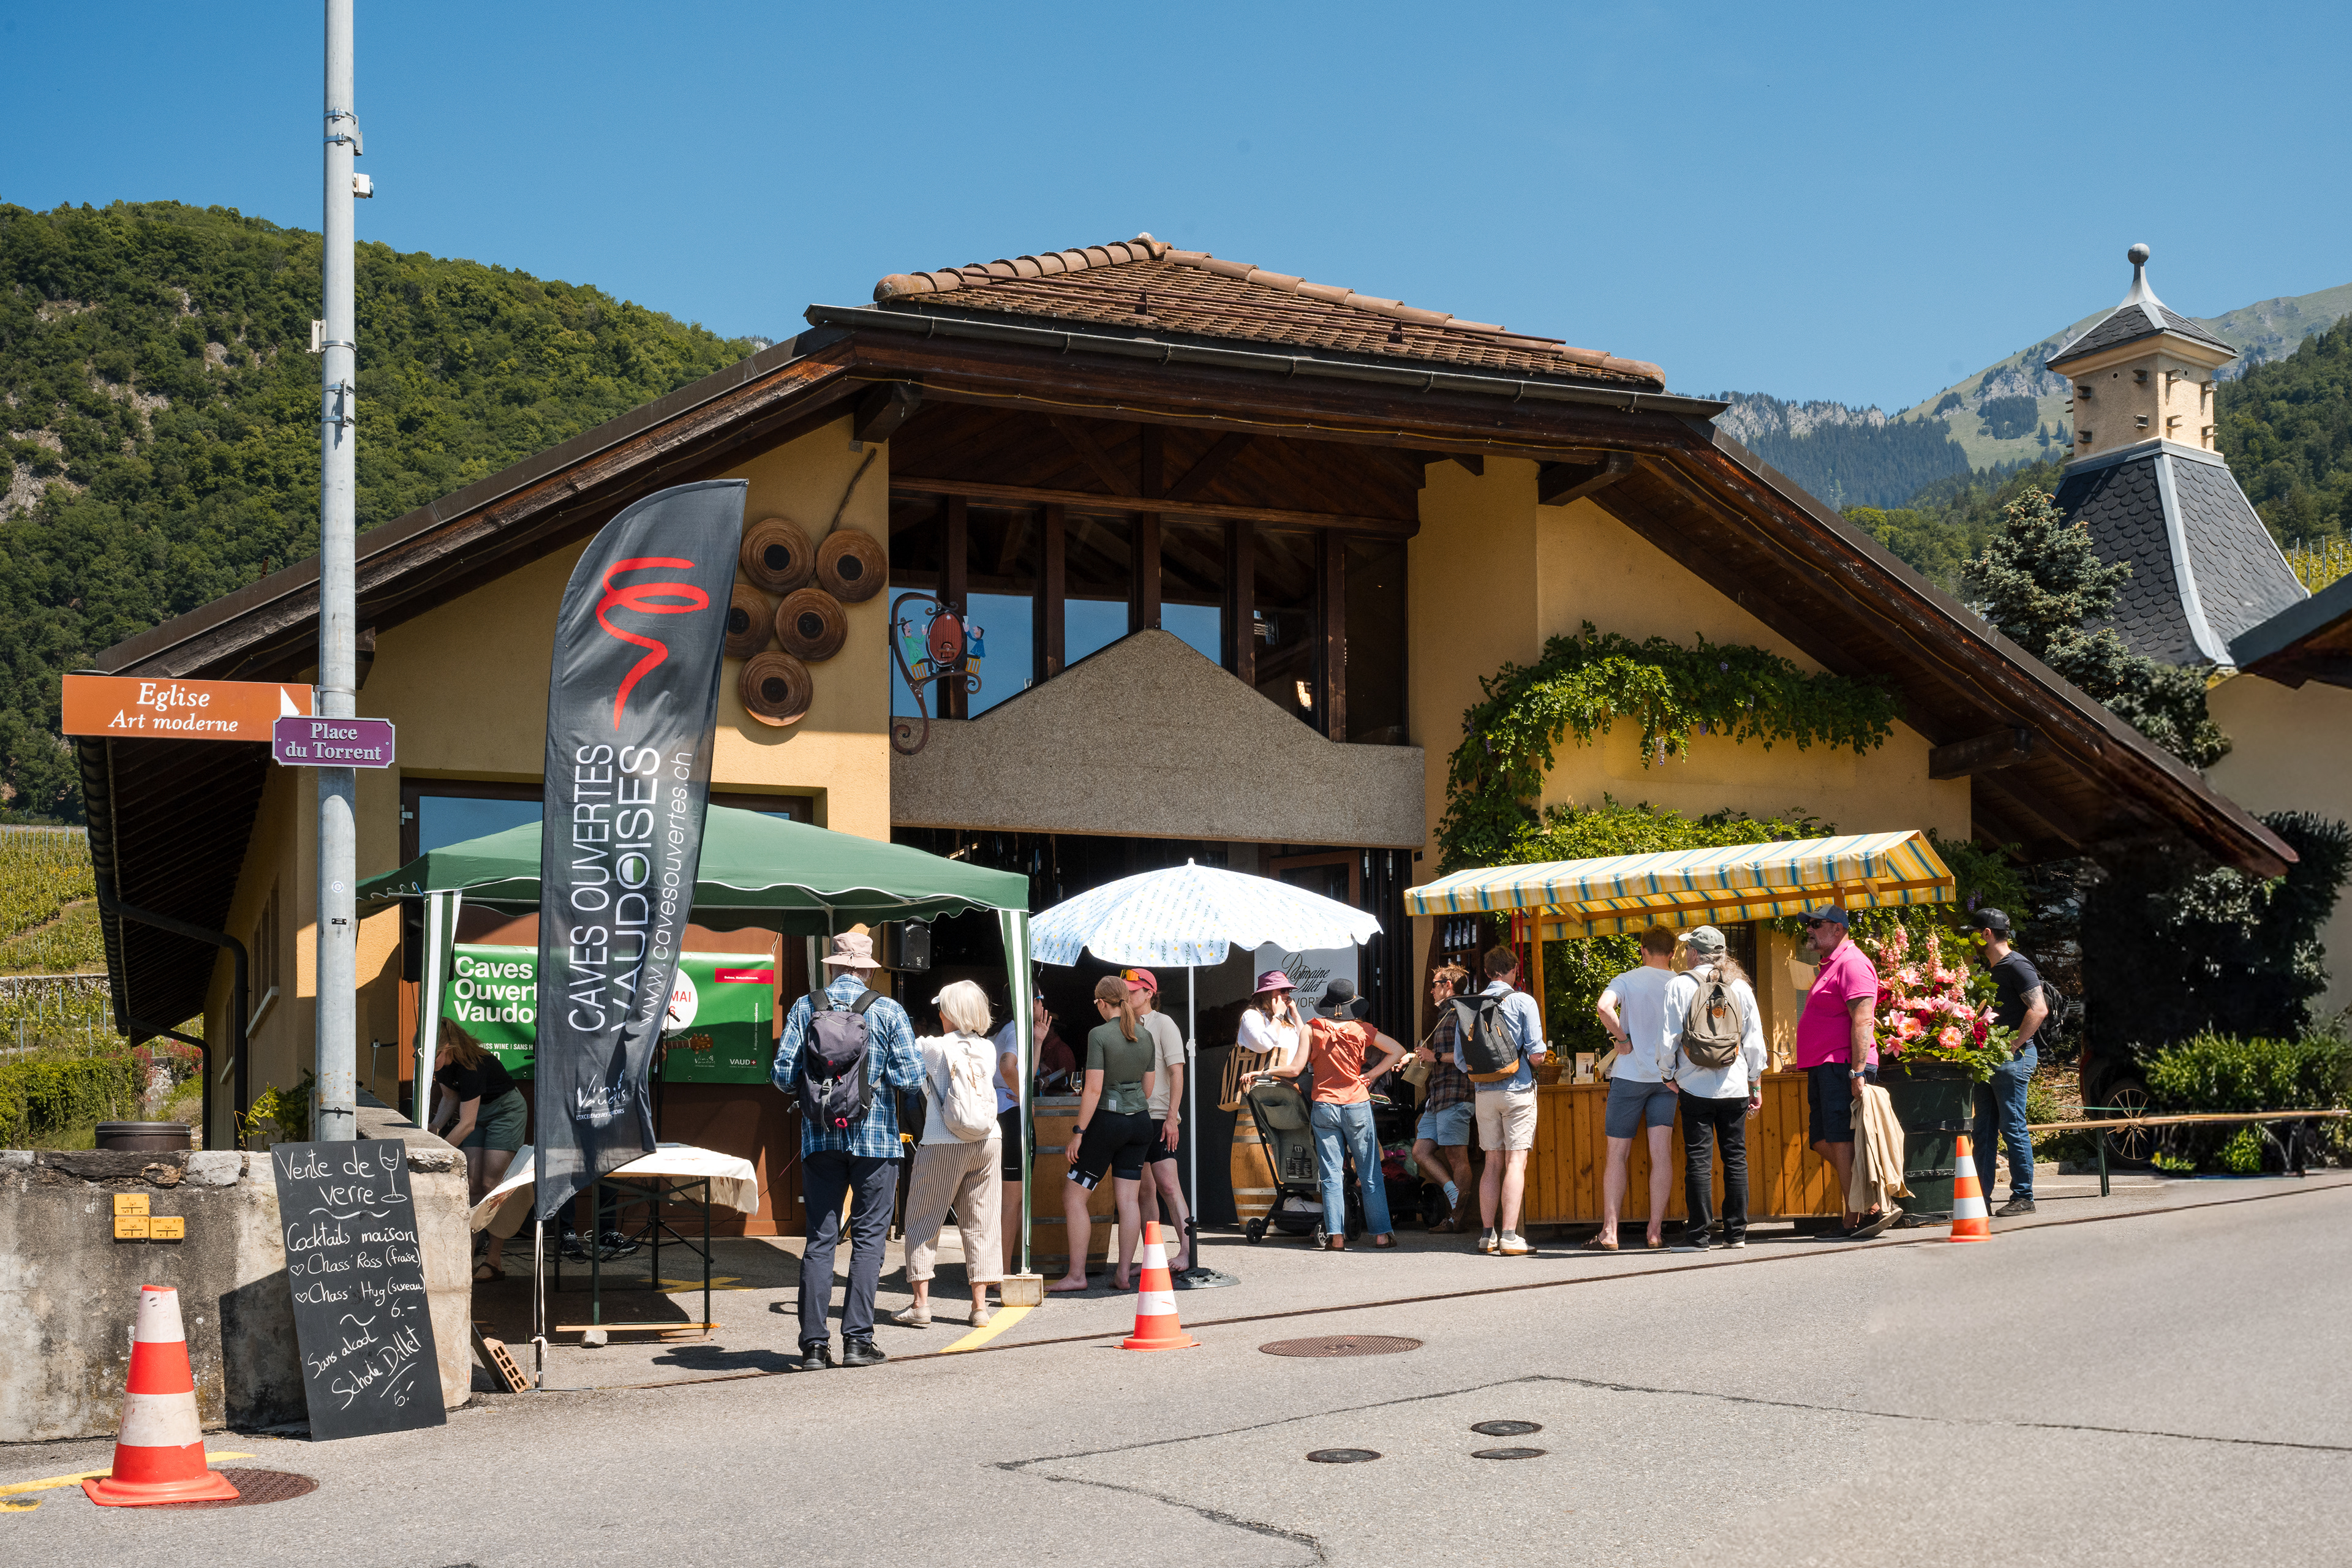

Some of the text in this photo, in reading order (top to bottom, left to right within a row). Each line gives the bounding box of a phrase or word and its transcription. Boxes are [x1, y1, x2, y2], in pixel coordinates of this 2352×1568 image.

[137, 683, 211, 712] Eglise
[108, 709, 238, 732] Art moderne
[310, 723, 358, 741] Place
[285, 742, 382, 761] du Torrent
[568, 744, 613, 1031] CAVES OUVERTES
[638, 752, 692, 1028] www.cavesouvertes.ch
[455, 956, 533, 979] Caves
[1282, 952, 1330, 979] Domaine
[1289, 965, 1327, 993] Dillet
[454, 978, 537, 1001] Ouvert
[671, 990, 691, 1002] MAI
[276, 1146, 375, 1180] Vente de
[318, 1185, 375, 1205] verre
[287, 1221, 418, 1251] Cocktails maison
[357, 1251, 383, 1268] Ross
[386, 1245, 421, 1268] (fraise)
[361, 1281, 385, 1306] Hug
[387, 1273, 426, 1294] (sureau)
[307, 1327, 379, 1379] Sans alcool
[377, 1325, 422, 1377] Dillet
